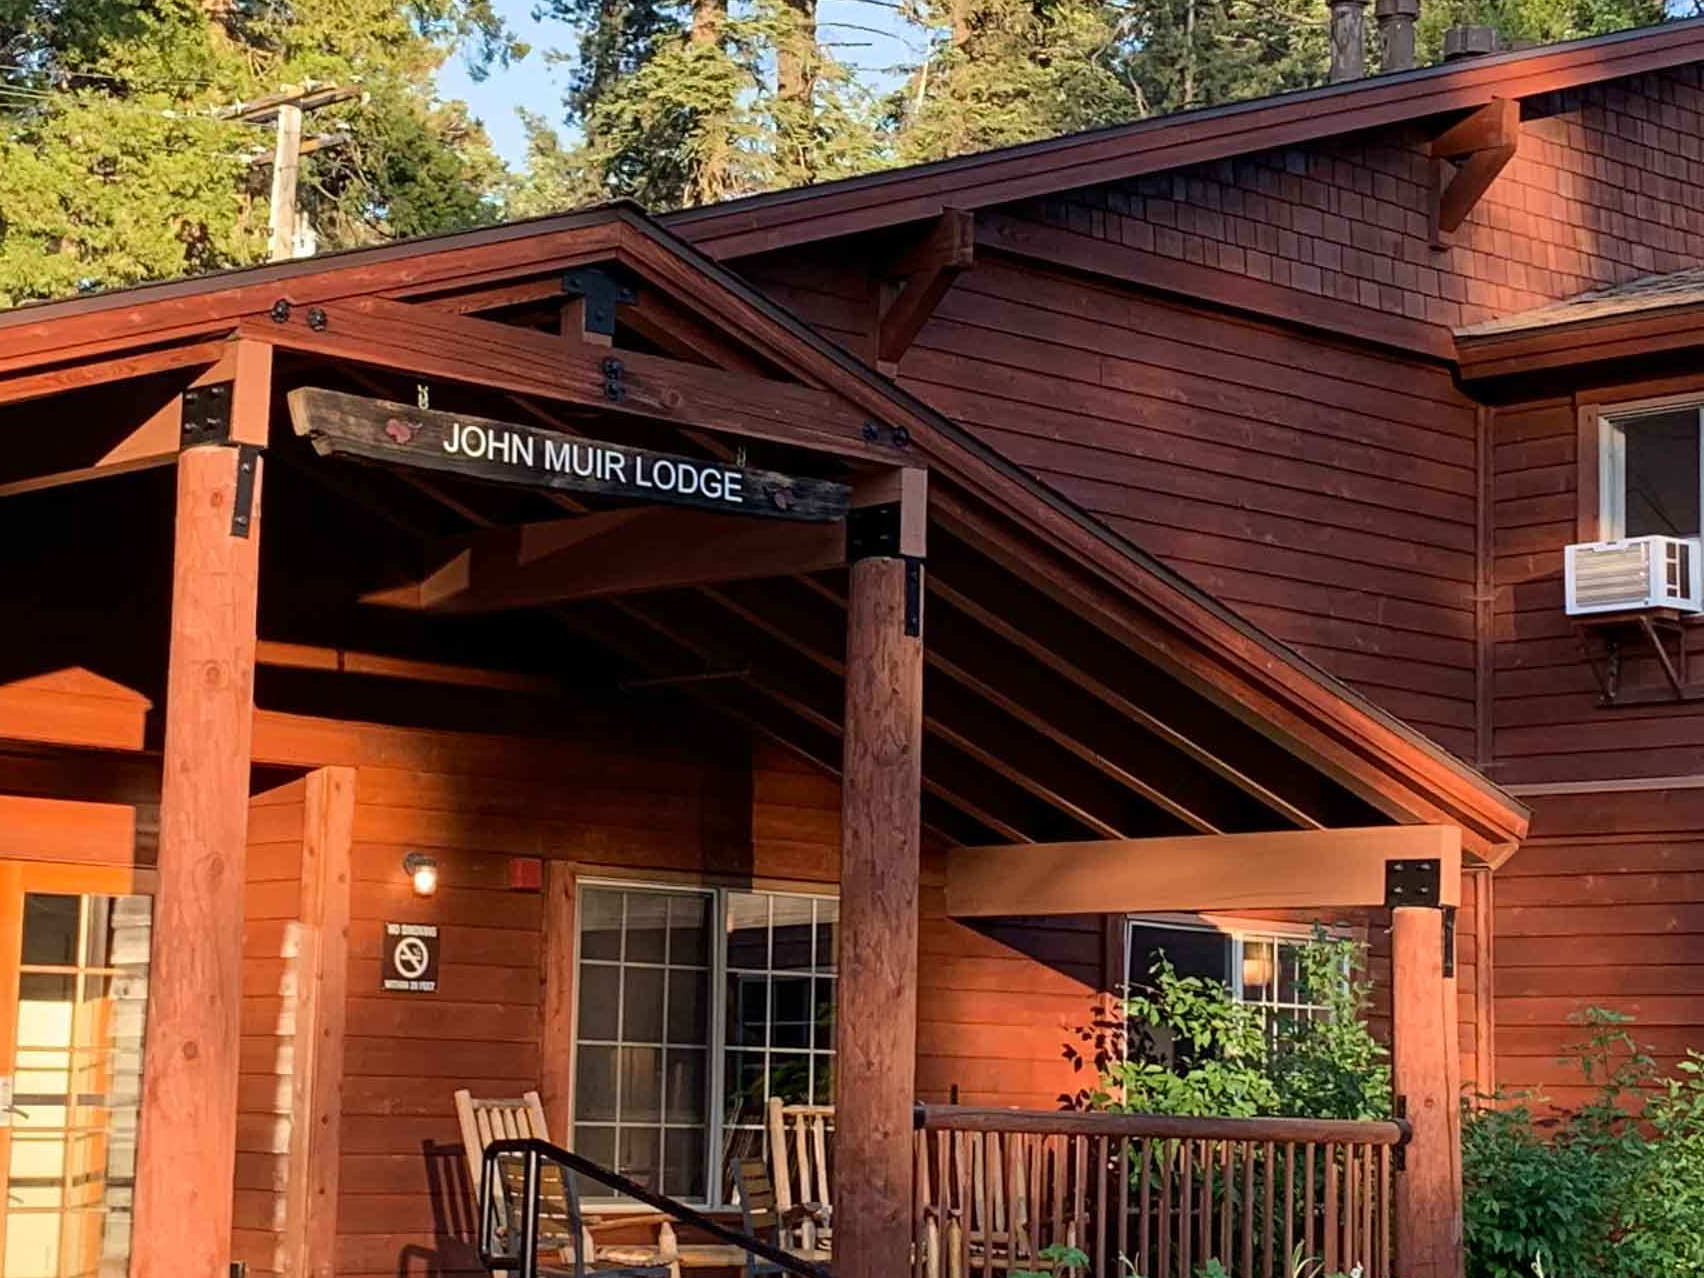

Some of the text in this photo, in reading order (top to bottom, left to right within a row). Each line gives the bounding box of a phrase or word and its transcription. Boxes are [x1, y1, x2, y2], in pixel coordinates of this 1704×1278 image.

[442, 422, 744, 504] JOHN MUIR LODGE
